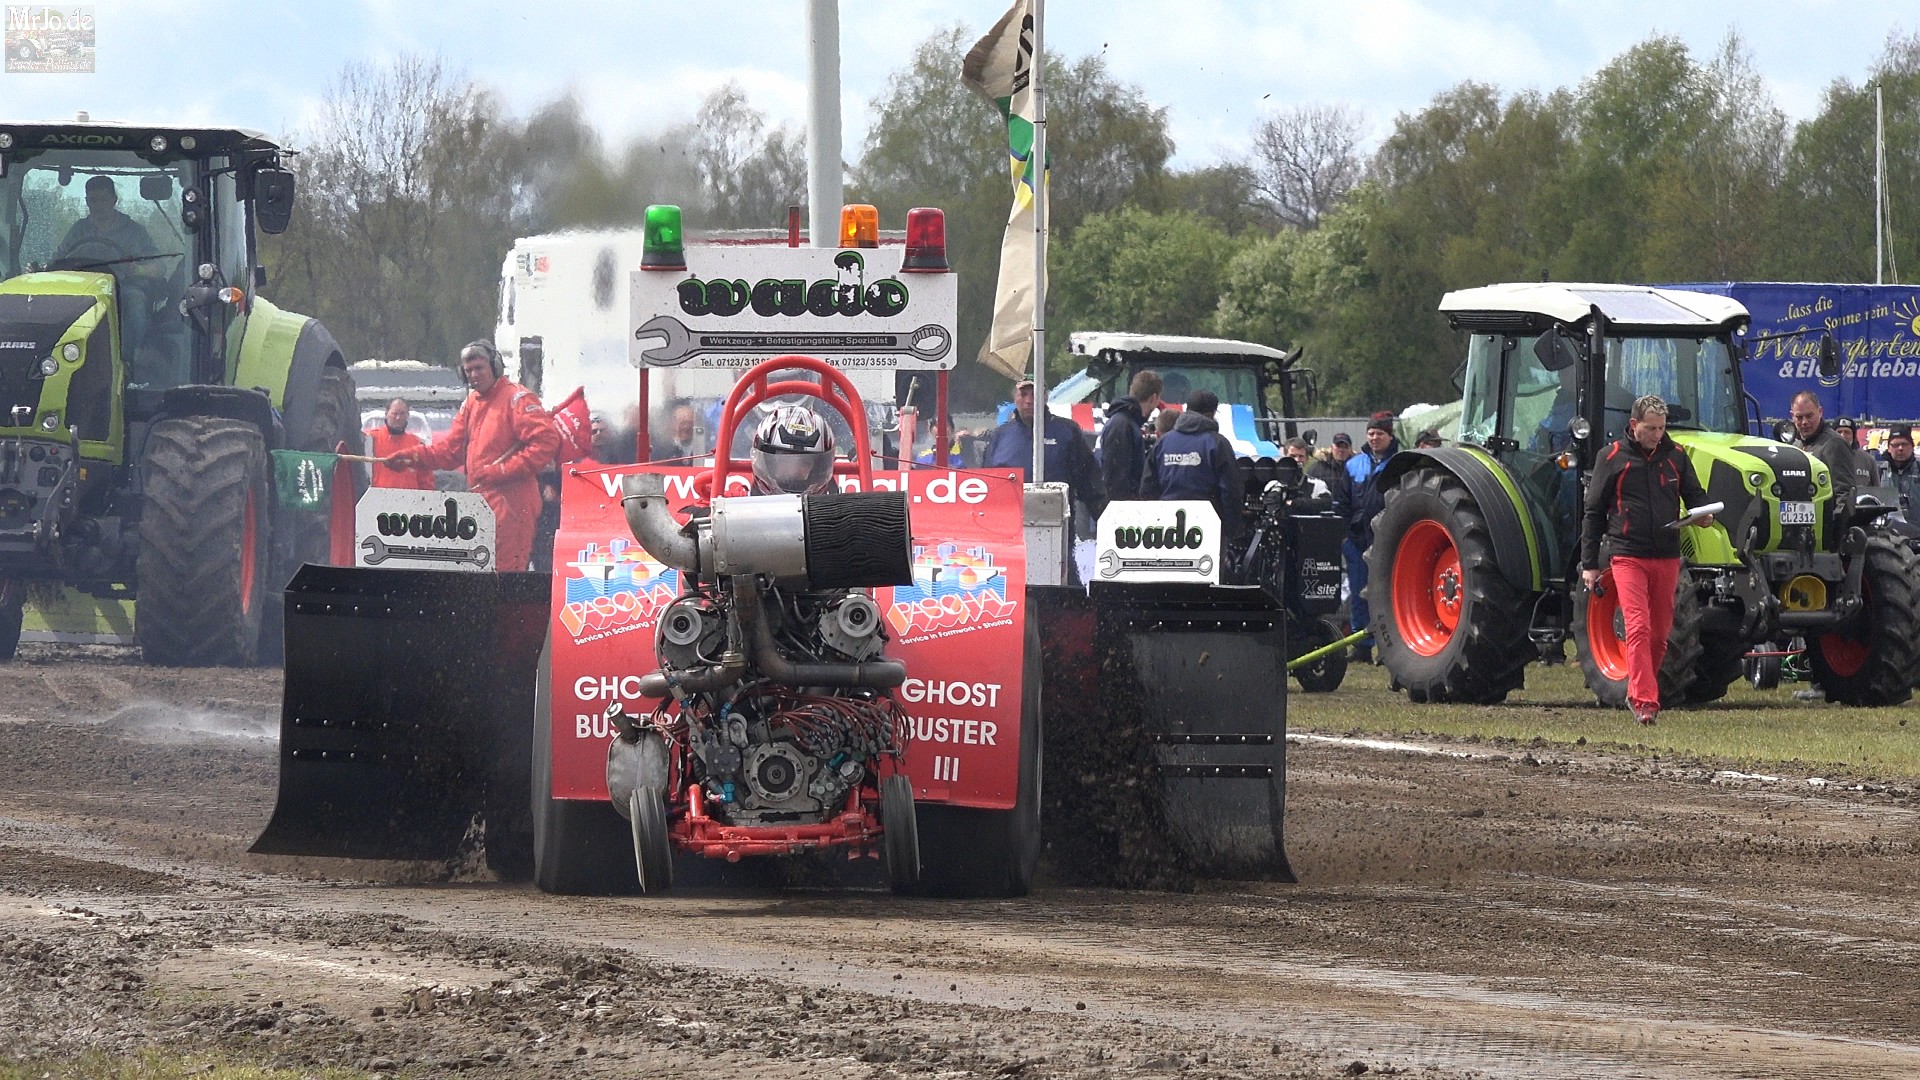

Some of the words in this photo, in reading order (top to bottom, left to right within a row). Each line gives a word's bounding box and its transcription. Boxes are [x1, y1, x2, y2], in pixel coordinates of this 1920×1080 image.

[41, 134, 124, 144] AXION
[677, 250, 910, 317] wado
[1815, 296, 1833, 313] die
[709, 336, 755, 345] Werkzeug-
[846, 336, 888, 345] Spezialist
[700, 358, 714, 366] Tel.
[842, 357, 898, 367] 07123/35539
[376, 498, 477, 540] wado
[1115, 508, 1203, 549] wado
[887, 588, 1017, 636] PASCHAL
[574, 633, 604, 645] Service
[612, 620, 650, 635] Schalung
[900, 634, 929, 645] Service
[938, 625, 976, 637] Formwork
[982, 619, 1013, 629] Shoring
[901, 676, 1001, 707] GHOST
[899, 716, 997, 745] BUSTER
[933, 755, 959, 781] III
